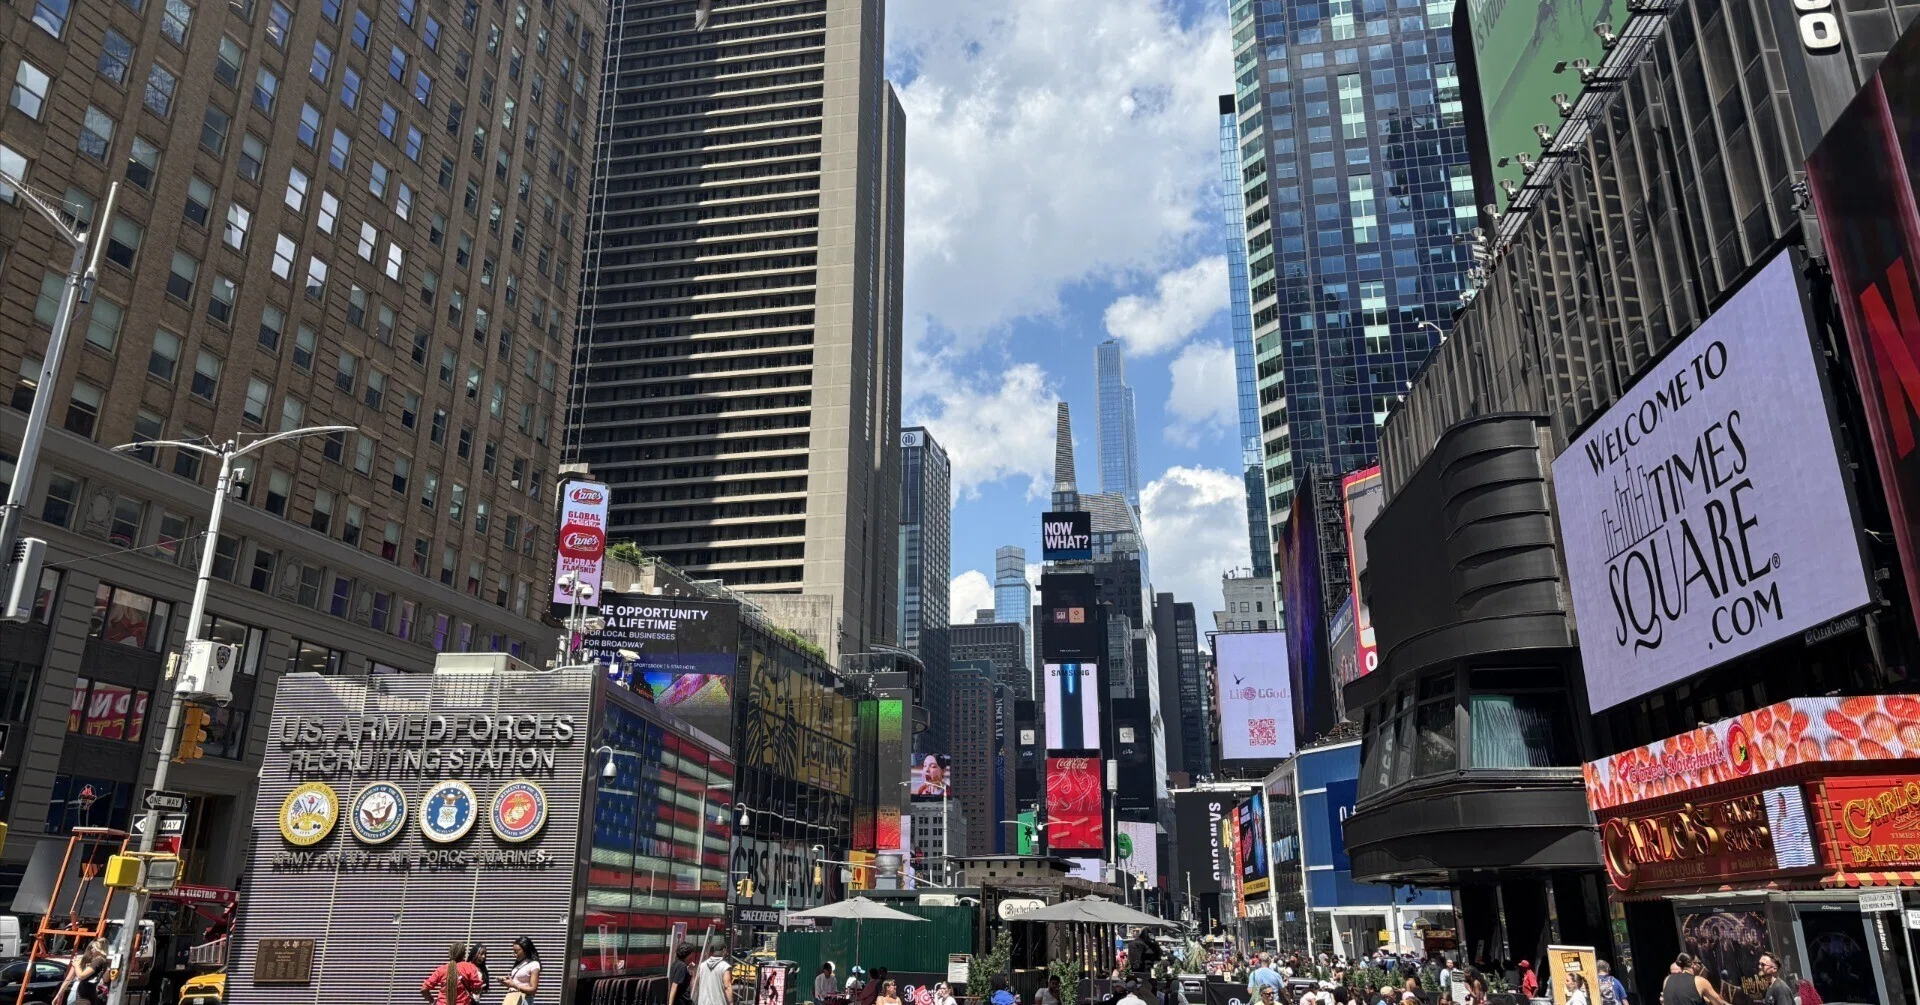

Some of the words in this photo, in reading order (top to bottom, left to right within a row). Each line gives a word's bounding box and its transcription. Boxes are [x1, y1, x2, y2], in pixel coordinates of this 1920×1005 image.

[1584, 368, 1692, 478] WELCOME
[1690, 340, 1728, 392] TO
[1648, 409, 1747, 524] TIMES
[568, 510, 601, 522] GLOBAL
[1044, 521, 1074, 536] NOW
[564, 532, 599, 549] Cane's
[1045, 534, 1090, 549] WHAT?
[616, 605, 709, 620] OPPORTUNITY
[1708, 580, 1784, 651] .COM
[606, 616, 617, 628] A
[619, 618, 677, 630] LIFETIME
[602, 630, 627, 638] LOCAL
[628, 631, 676, 641] BUSINESSES
[584, 639, 600, 647] FOR
[601, 640, 644, 649] BROADWAY
[280, 715, 327, 742] U.S.
[332, 714, 447, 741] ARMED
[451, 713, 574, 740] FORCES
[286, 748, 441, 772] RECRUITING
[447, 746, 556, 770] STATION
[149, 797, 162, 805] ONE
[166, 798, 180, 807] WAY
[161, 820, 178, 830] WAY
[270, 851, 314, 866] ARMY
[1851, 844, 1902, 863] BAKE
[186, 888, 217, 900] ELECTRIC
[740, 909, 779, 924] SKECHERS
